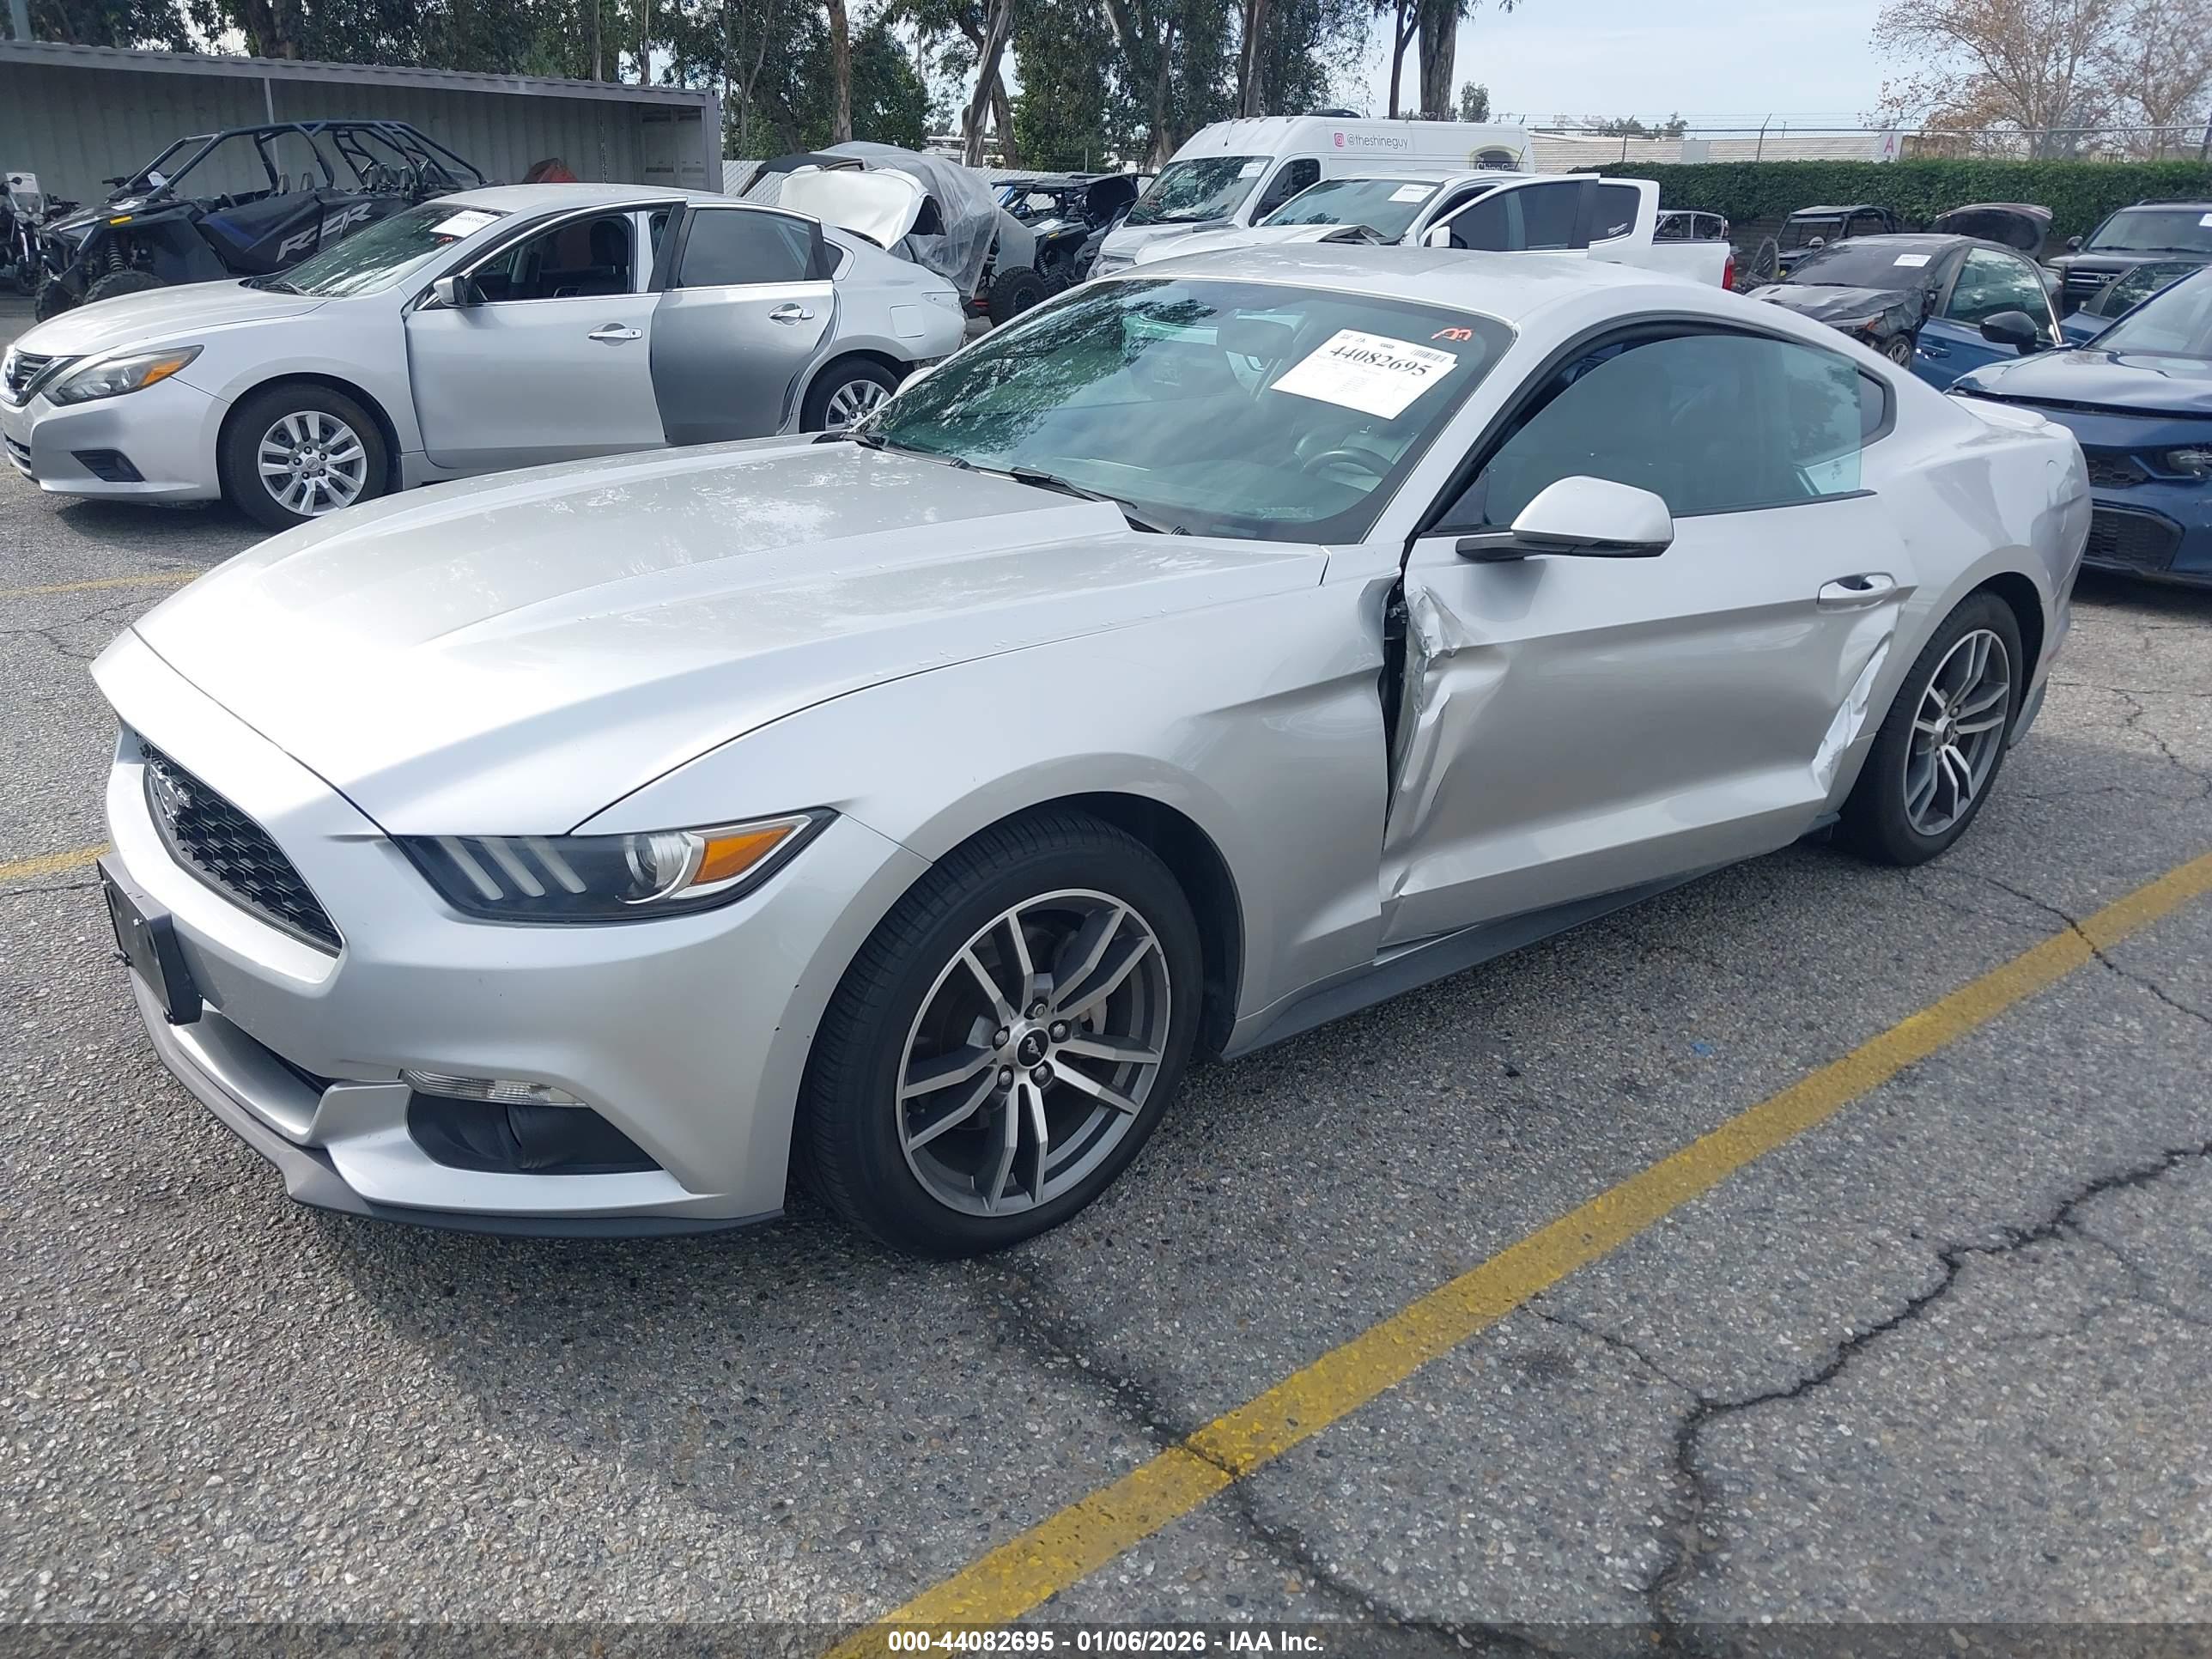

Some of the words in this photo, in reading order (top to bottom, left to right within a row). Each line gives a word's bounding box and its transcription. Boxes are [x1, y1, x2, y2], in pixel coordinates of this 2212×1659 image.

[1346, 133, 1408, 150] @theshineguy
[1883, 133, 1894, 153] A
[276, 202, 373, 264] RZR
[1329, 345, 1433, 377] 44082695
